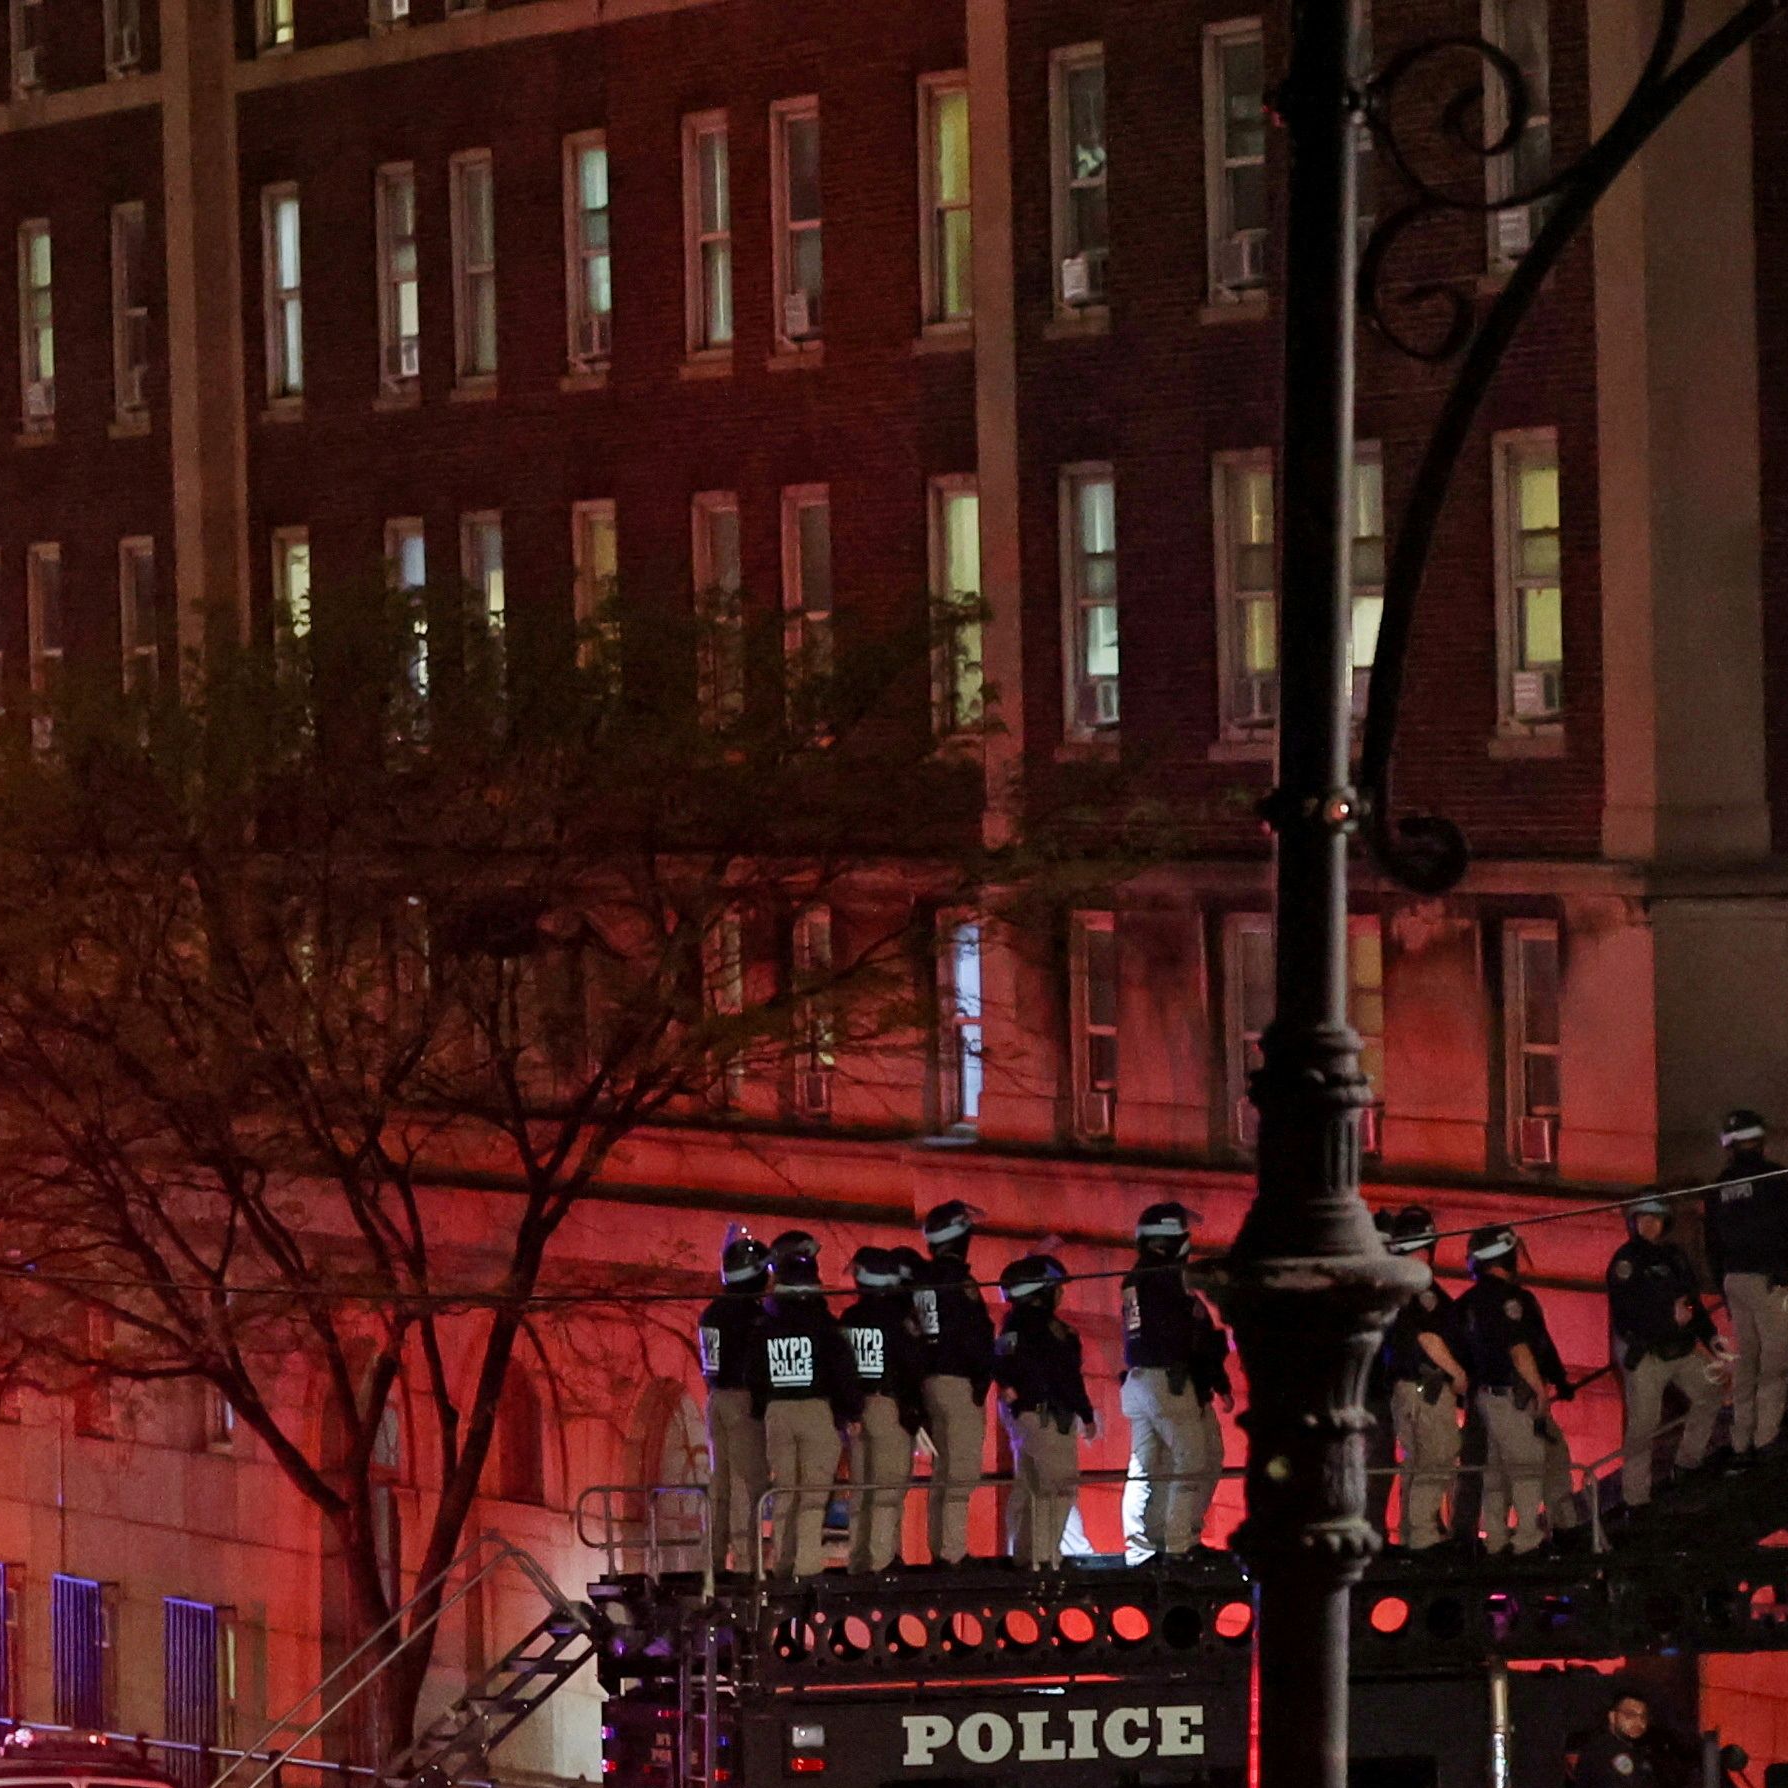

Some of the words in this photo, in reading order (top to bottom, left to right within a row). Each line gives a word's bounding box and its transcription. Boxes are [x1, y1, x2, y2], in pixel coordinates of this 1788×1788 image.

[767, 1337, 812, 1360] NYPD
[854, 1350, 883, 1366] LICE
[770, 1358, 813, 1376] POLICE
[902, 1705, 1204, 1765] POLICE
